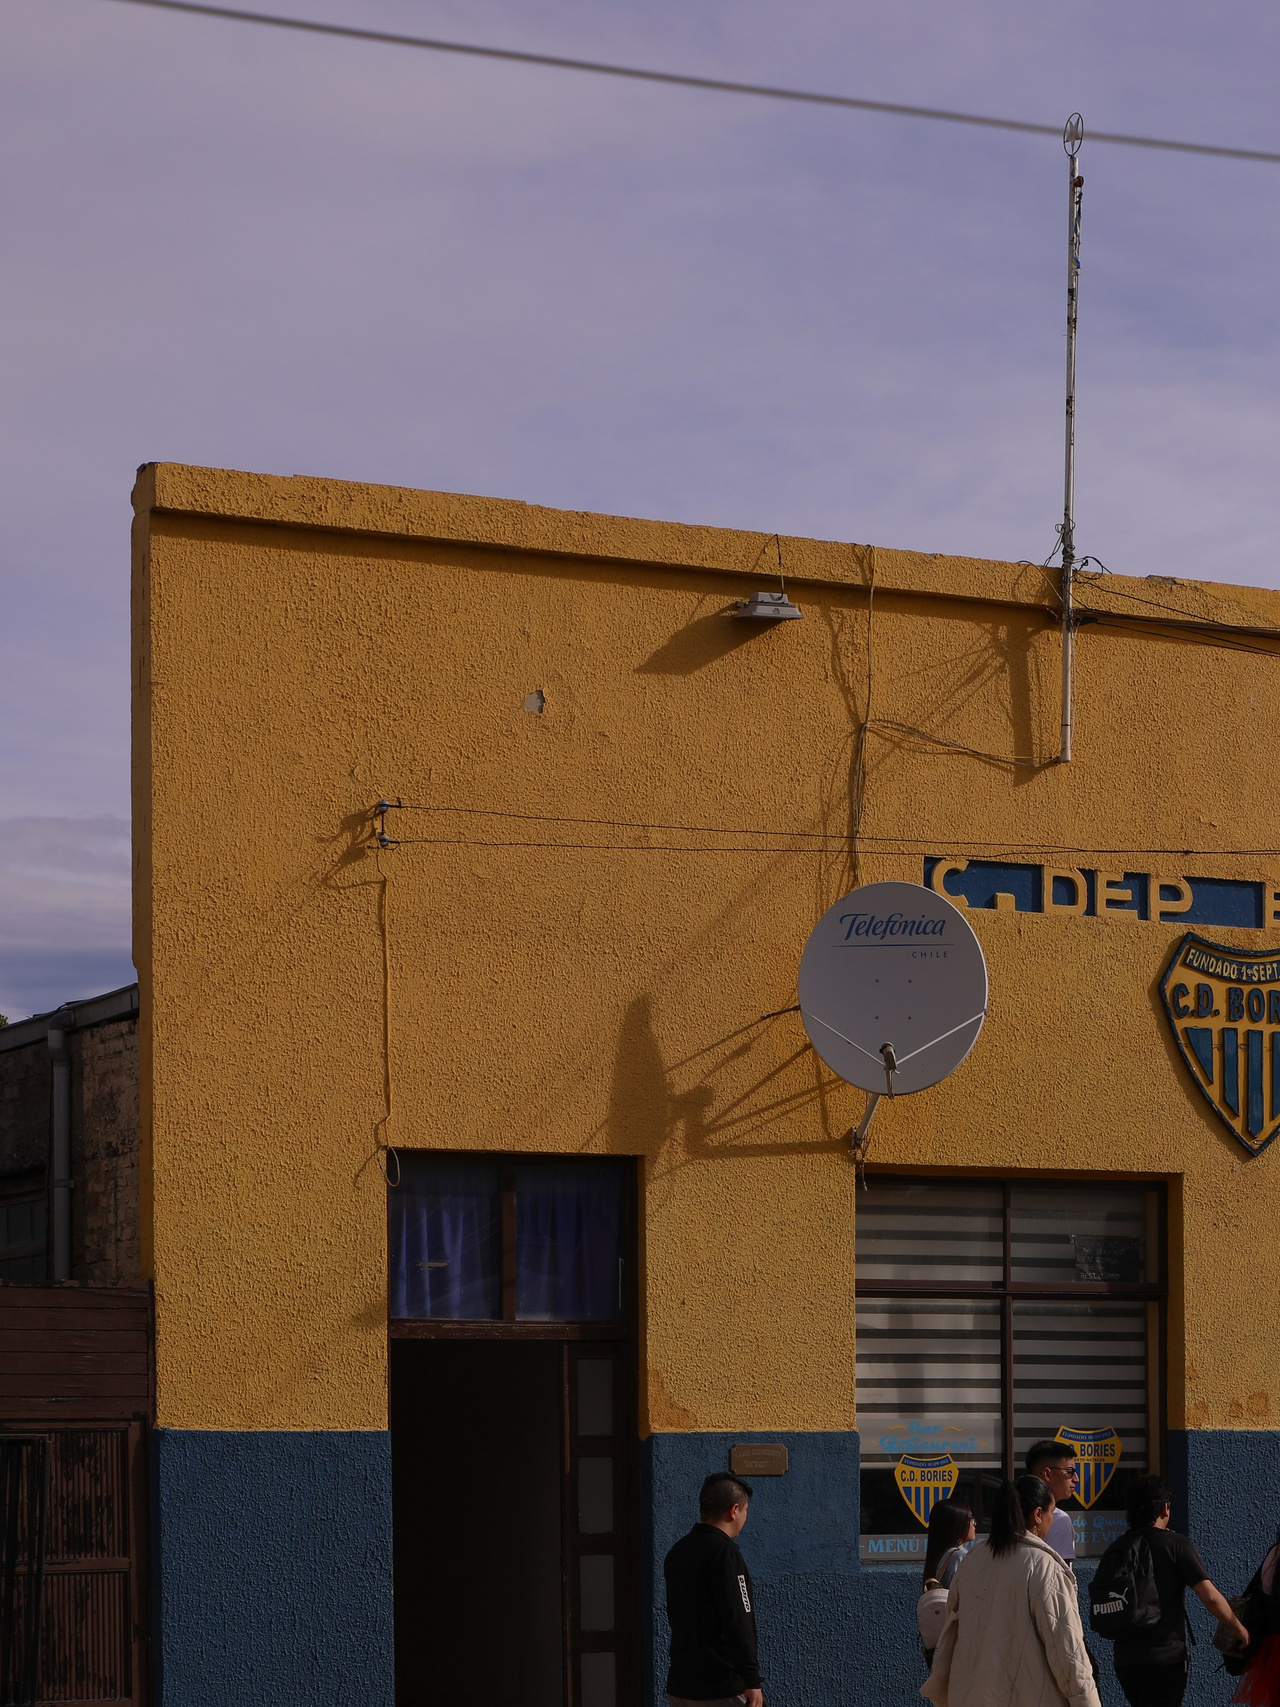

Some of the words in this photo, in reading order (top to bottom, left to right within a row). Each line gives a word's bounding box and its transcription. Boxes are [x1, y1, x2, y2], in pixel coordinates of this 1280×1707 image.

[1043, 864, 1193, 921] DEP
[911, 951, 948, 959] CHILE
[1185, 948, 1238, 979] FUNDADO
[1172, 982, 1220, 1019] C.D.
[908, 1420, 943, 1435] Bar
[1061, 1431, 1087, 1440] FUNDADO
[880, 1434, 979, 1453] Restaurant
[1080, 1443, 1116, 1457] BORIES
[900, 1469, 918, 1482] C.D.
[920, 1469, 953, 1482] BORIES
[1092, 1515, 1128, 1530] Quin
[867, 1536, 920, 1553] MENÚ
[1091, 1531, 1126, 1543] EVE
[1093, 1599, 1124, 1615] PUMA
